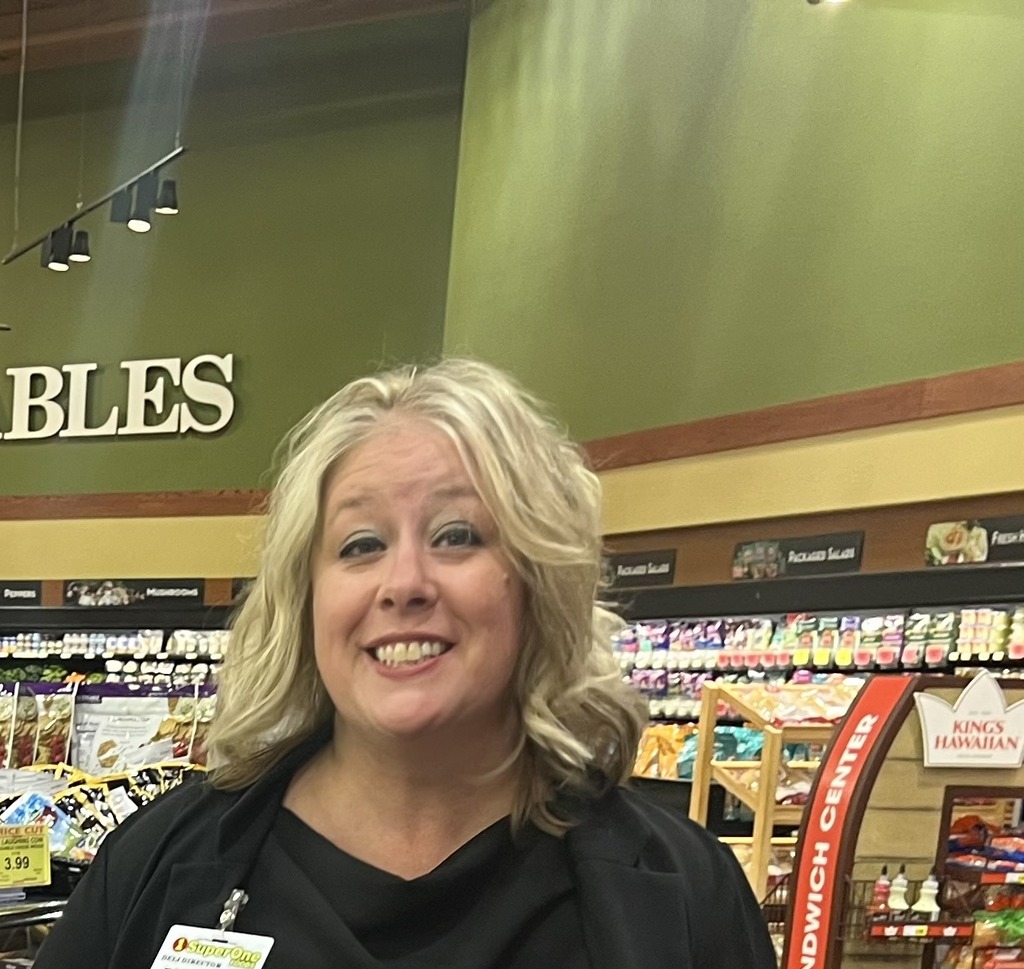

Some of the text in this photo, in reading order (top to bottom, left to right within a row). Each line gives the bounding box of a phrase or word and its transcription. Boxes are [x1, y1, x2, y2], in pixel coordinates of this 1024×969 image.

[935, 734, 1019, 751] HAWAIIAN
[819, 713, 879, 833] CENTER
[25, 825, 44, 835] CUT
[4, 856, 30, 870] 3.99
[182, 957, 222, 969] DIRECTOR
